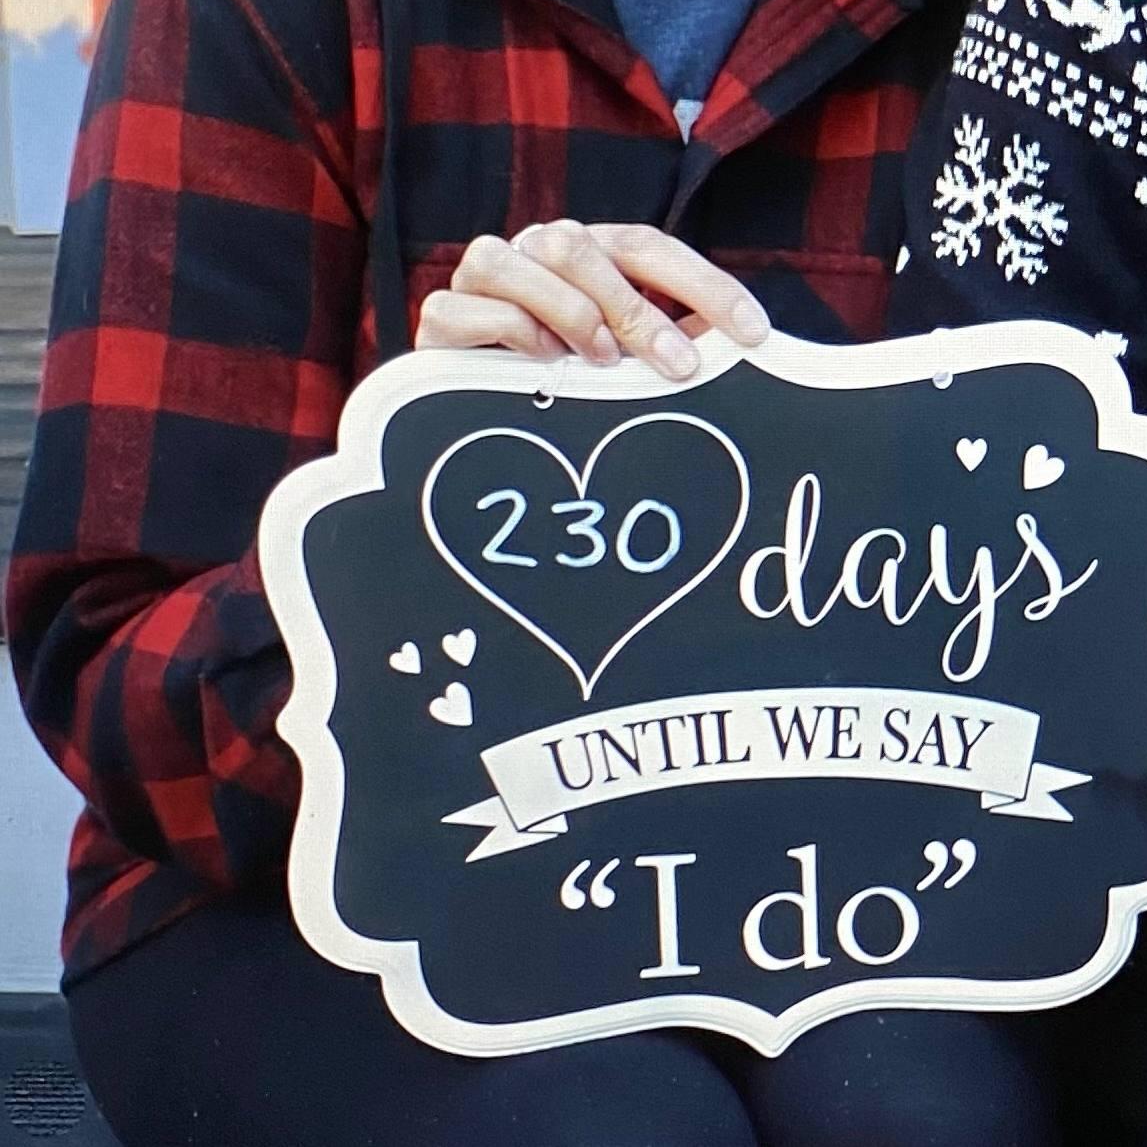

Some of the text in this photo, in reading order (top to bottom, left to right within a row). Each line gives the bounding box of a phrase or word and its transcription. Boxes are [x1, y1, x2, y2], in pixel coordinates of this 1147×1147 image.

[475, 473, 1098, 682] 230 days
[543, 705, 995, 792] UNTIL WE SAY
